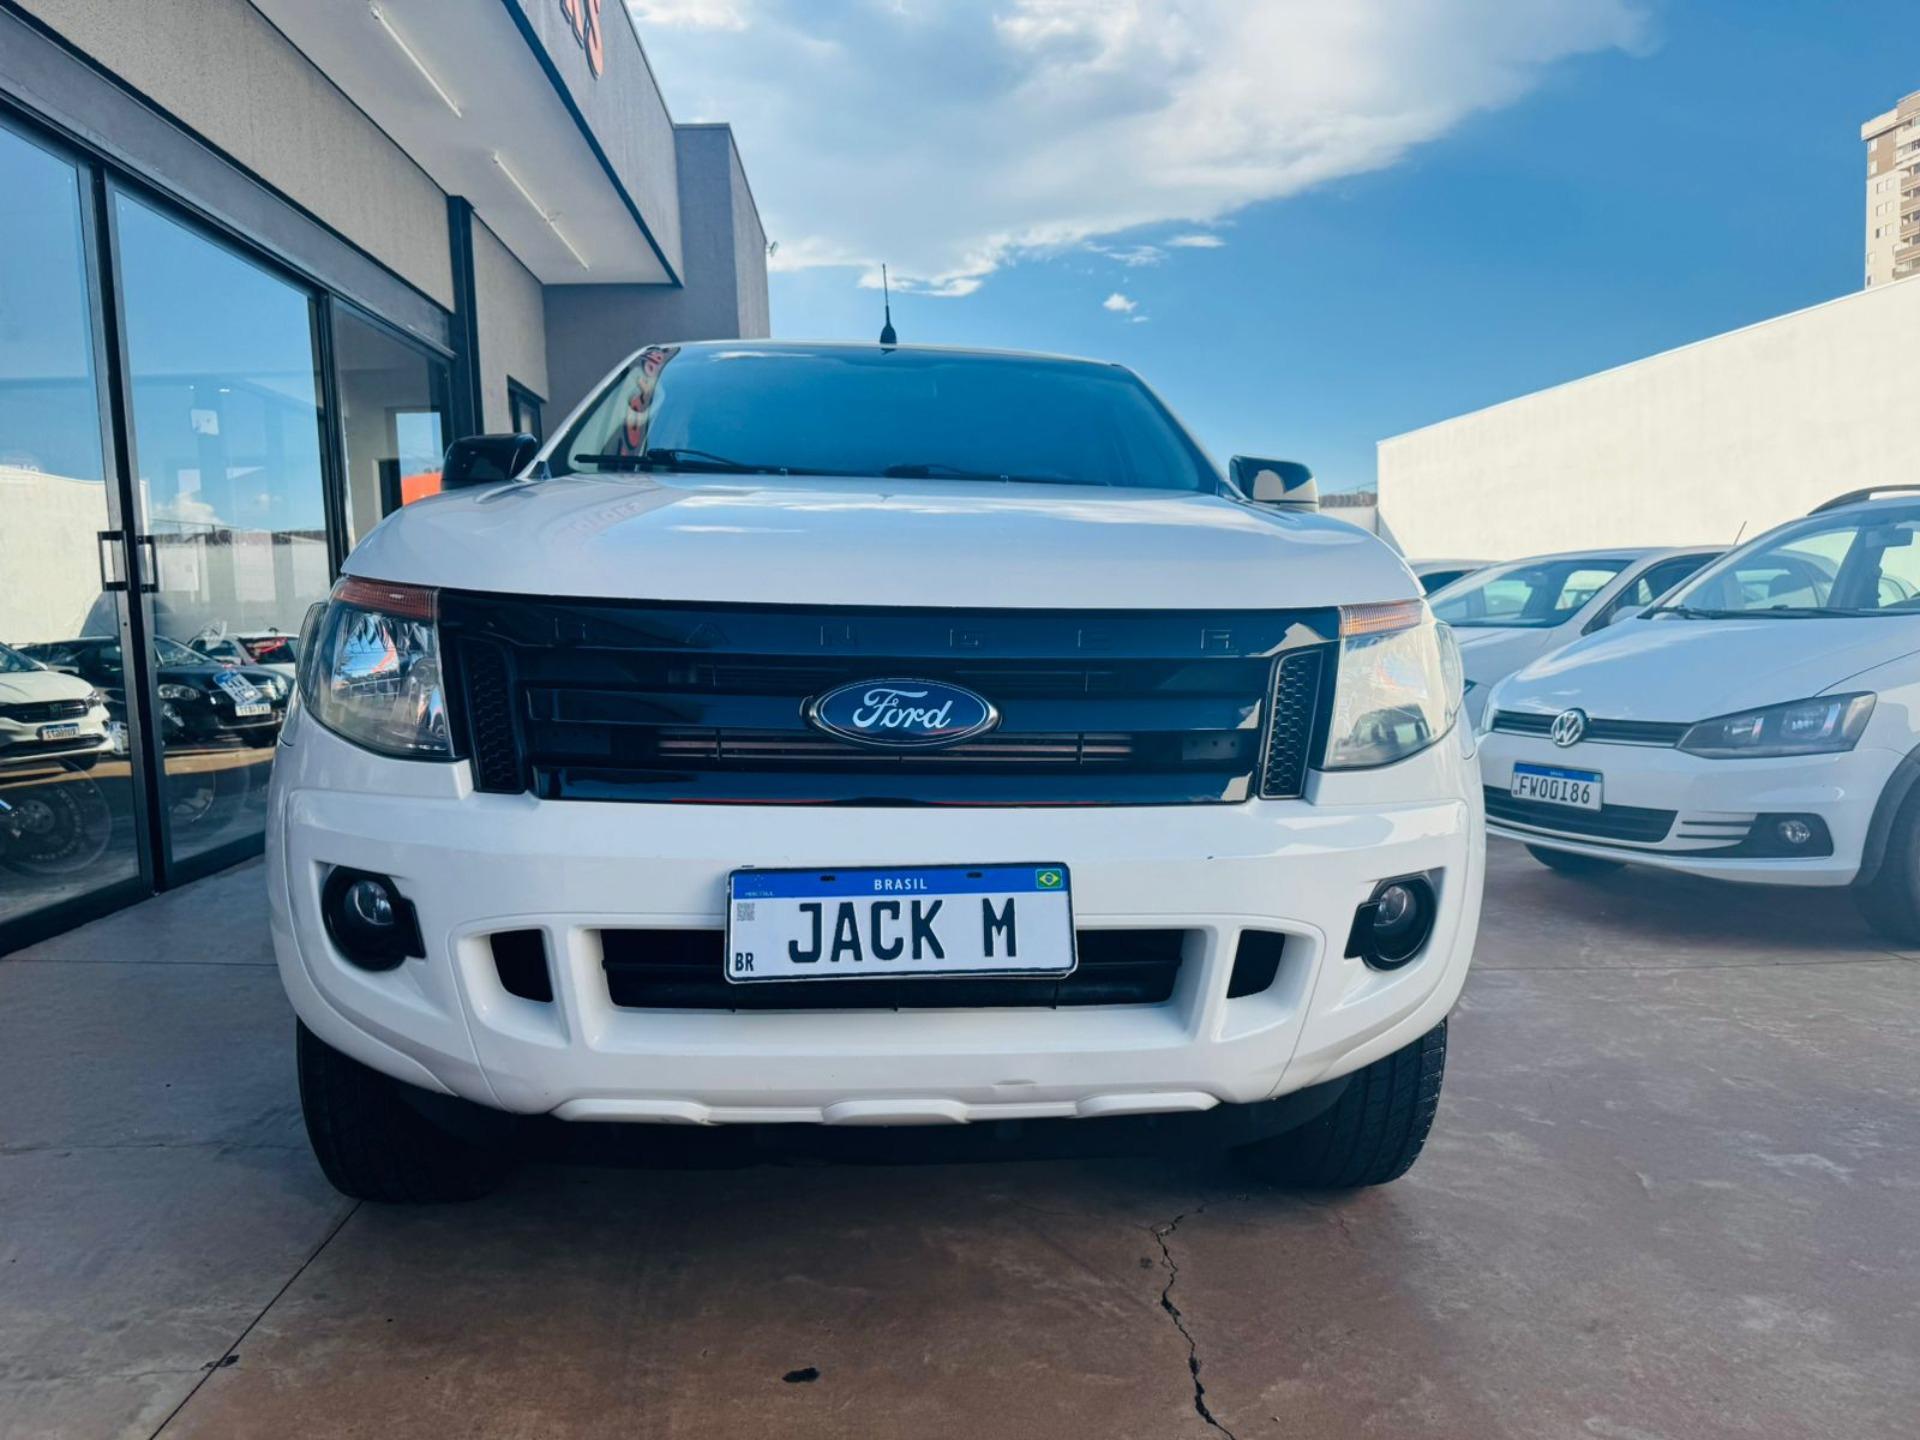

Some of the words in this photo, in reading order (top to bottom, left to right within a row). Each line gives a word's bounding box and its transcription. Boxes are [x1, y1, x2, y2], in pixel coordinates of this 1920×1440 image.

[852, 688, 953, 729] Ford
[873, 877, 929, 891] BRASIL
[788, 899, 946, 963] JACK
[982, 897, 1017, 957] M
[734, 952, 755, 972] BR
